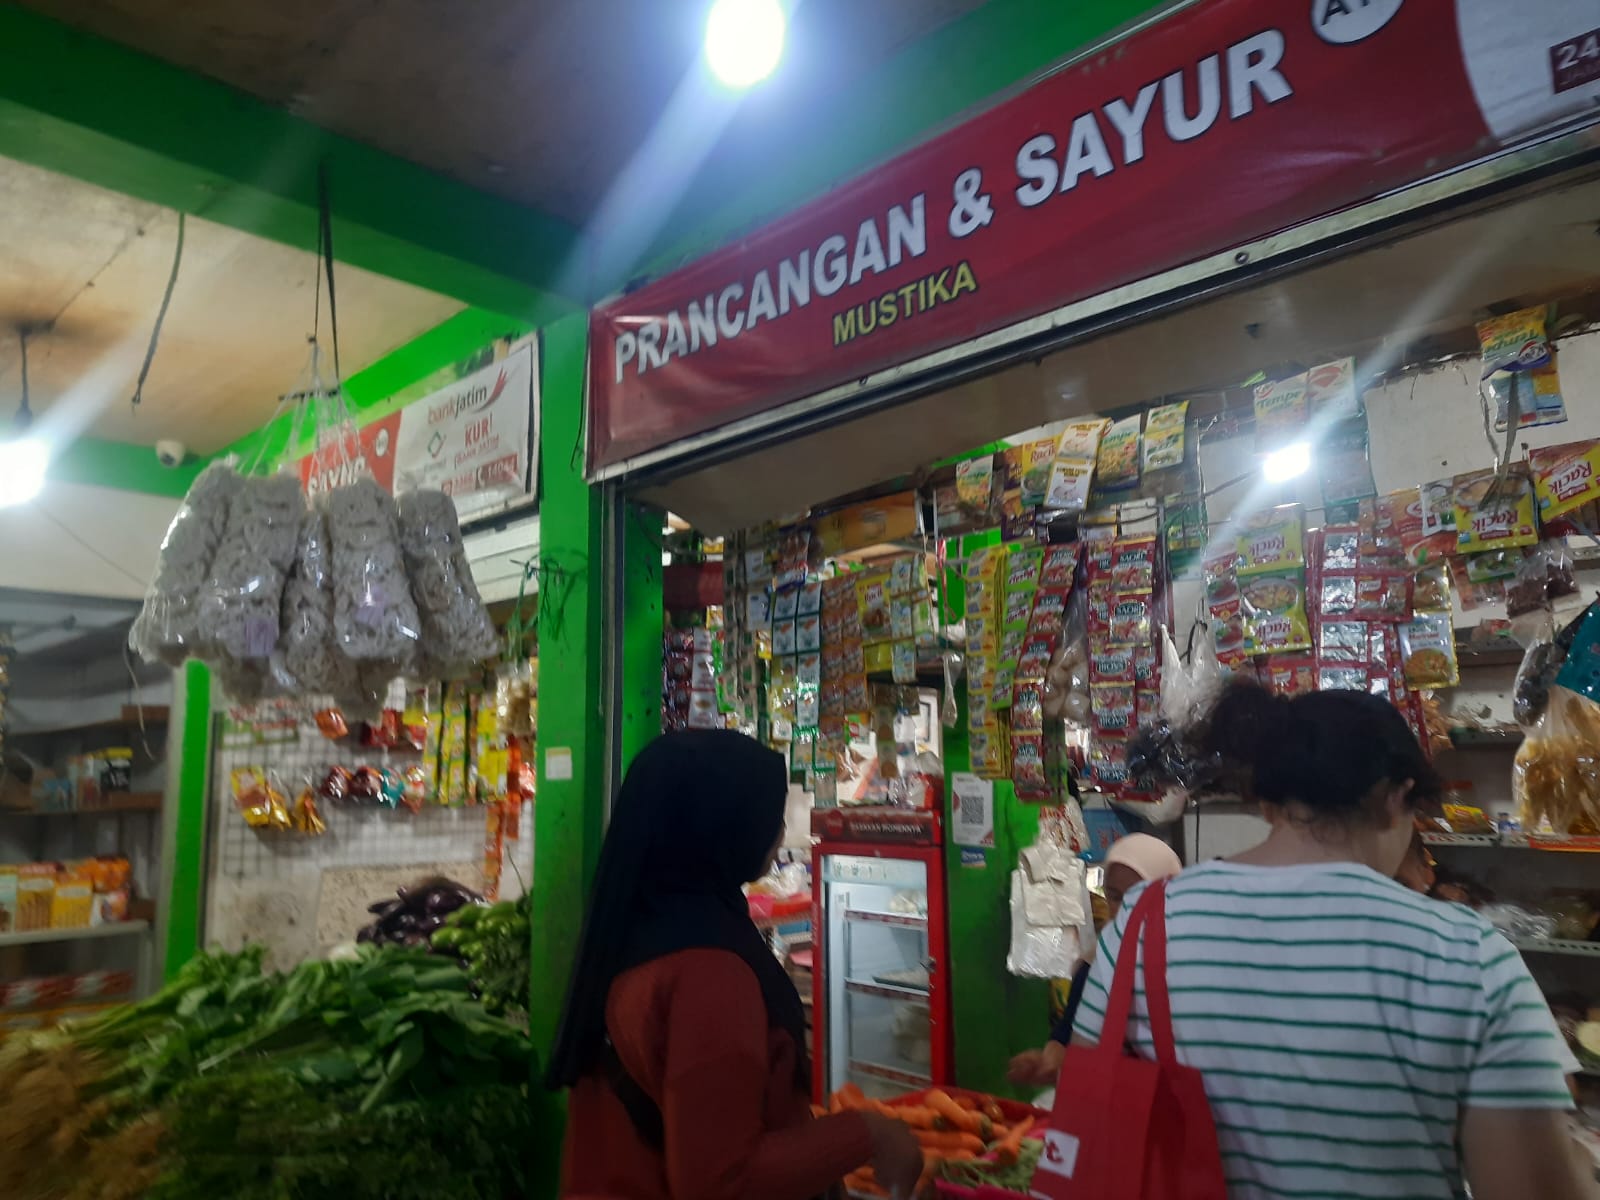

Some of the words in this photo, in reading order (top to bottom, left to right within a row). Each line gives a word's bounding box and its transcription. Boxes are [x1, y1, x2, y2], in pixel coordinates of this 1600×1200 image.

[613, 193, 928, 384] PRANCANGAN
[947, 166, 994, 239] &
[1013, 27, 1294, 207] SAYUR
[832, 261, 978, 346] MUSTIKA
[1547, 462, 1593, 497] Racik
[1472, 510, 1518, 532] Racik
[1247, 535, 1286, 556] Racik
